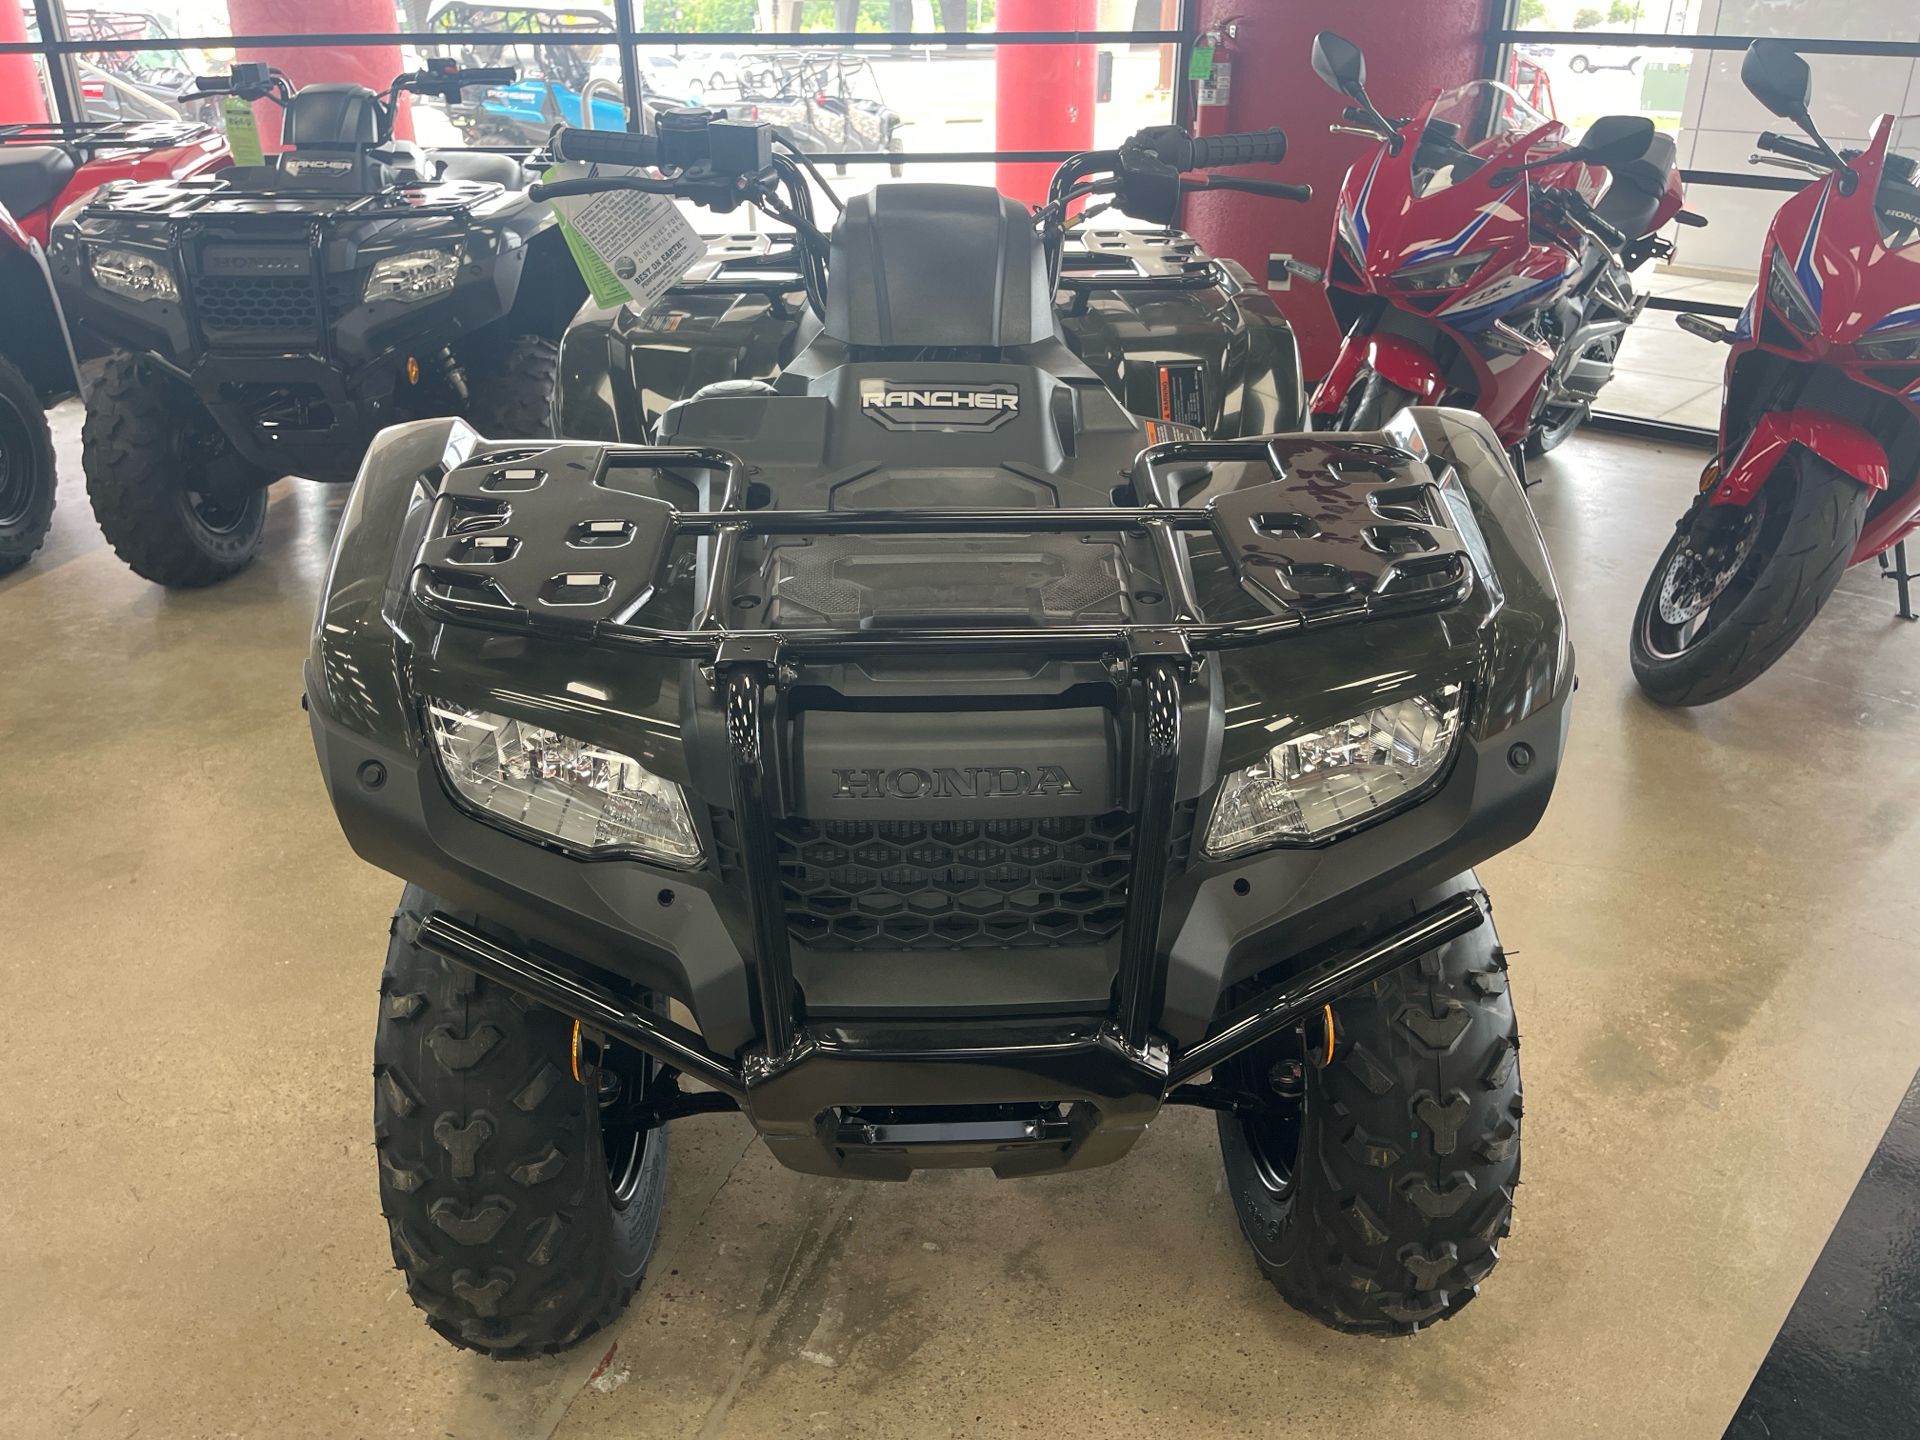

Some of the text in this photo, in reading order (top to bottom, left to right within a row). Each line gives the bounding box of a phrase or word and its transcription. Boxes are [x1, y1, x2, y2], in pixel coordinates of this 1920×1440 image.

[487, 90, 536, 100] PIONEER
[286, 160, 353, 170] RANCHER
[1885, 209, 1920, 225] HOND
[632, 214, 680, 257] BLUE SKIES FOR
[637, 221, 685, 264] OUR CHILDREN
[213, 256, 300, 269] HONDA
[633, 267, 653, 285] BEST
[650, 259, 662, 270] ON
[640, 259, 672, 288] PERFORMANCE
[863, 391, 1019, 410] RANCHER
[1161, 381, 1169, 411] WARNING
[831, 766, 1082, 799] HONDA
